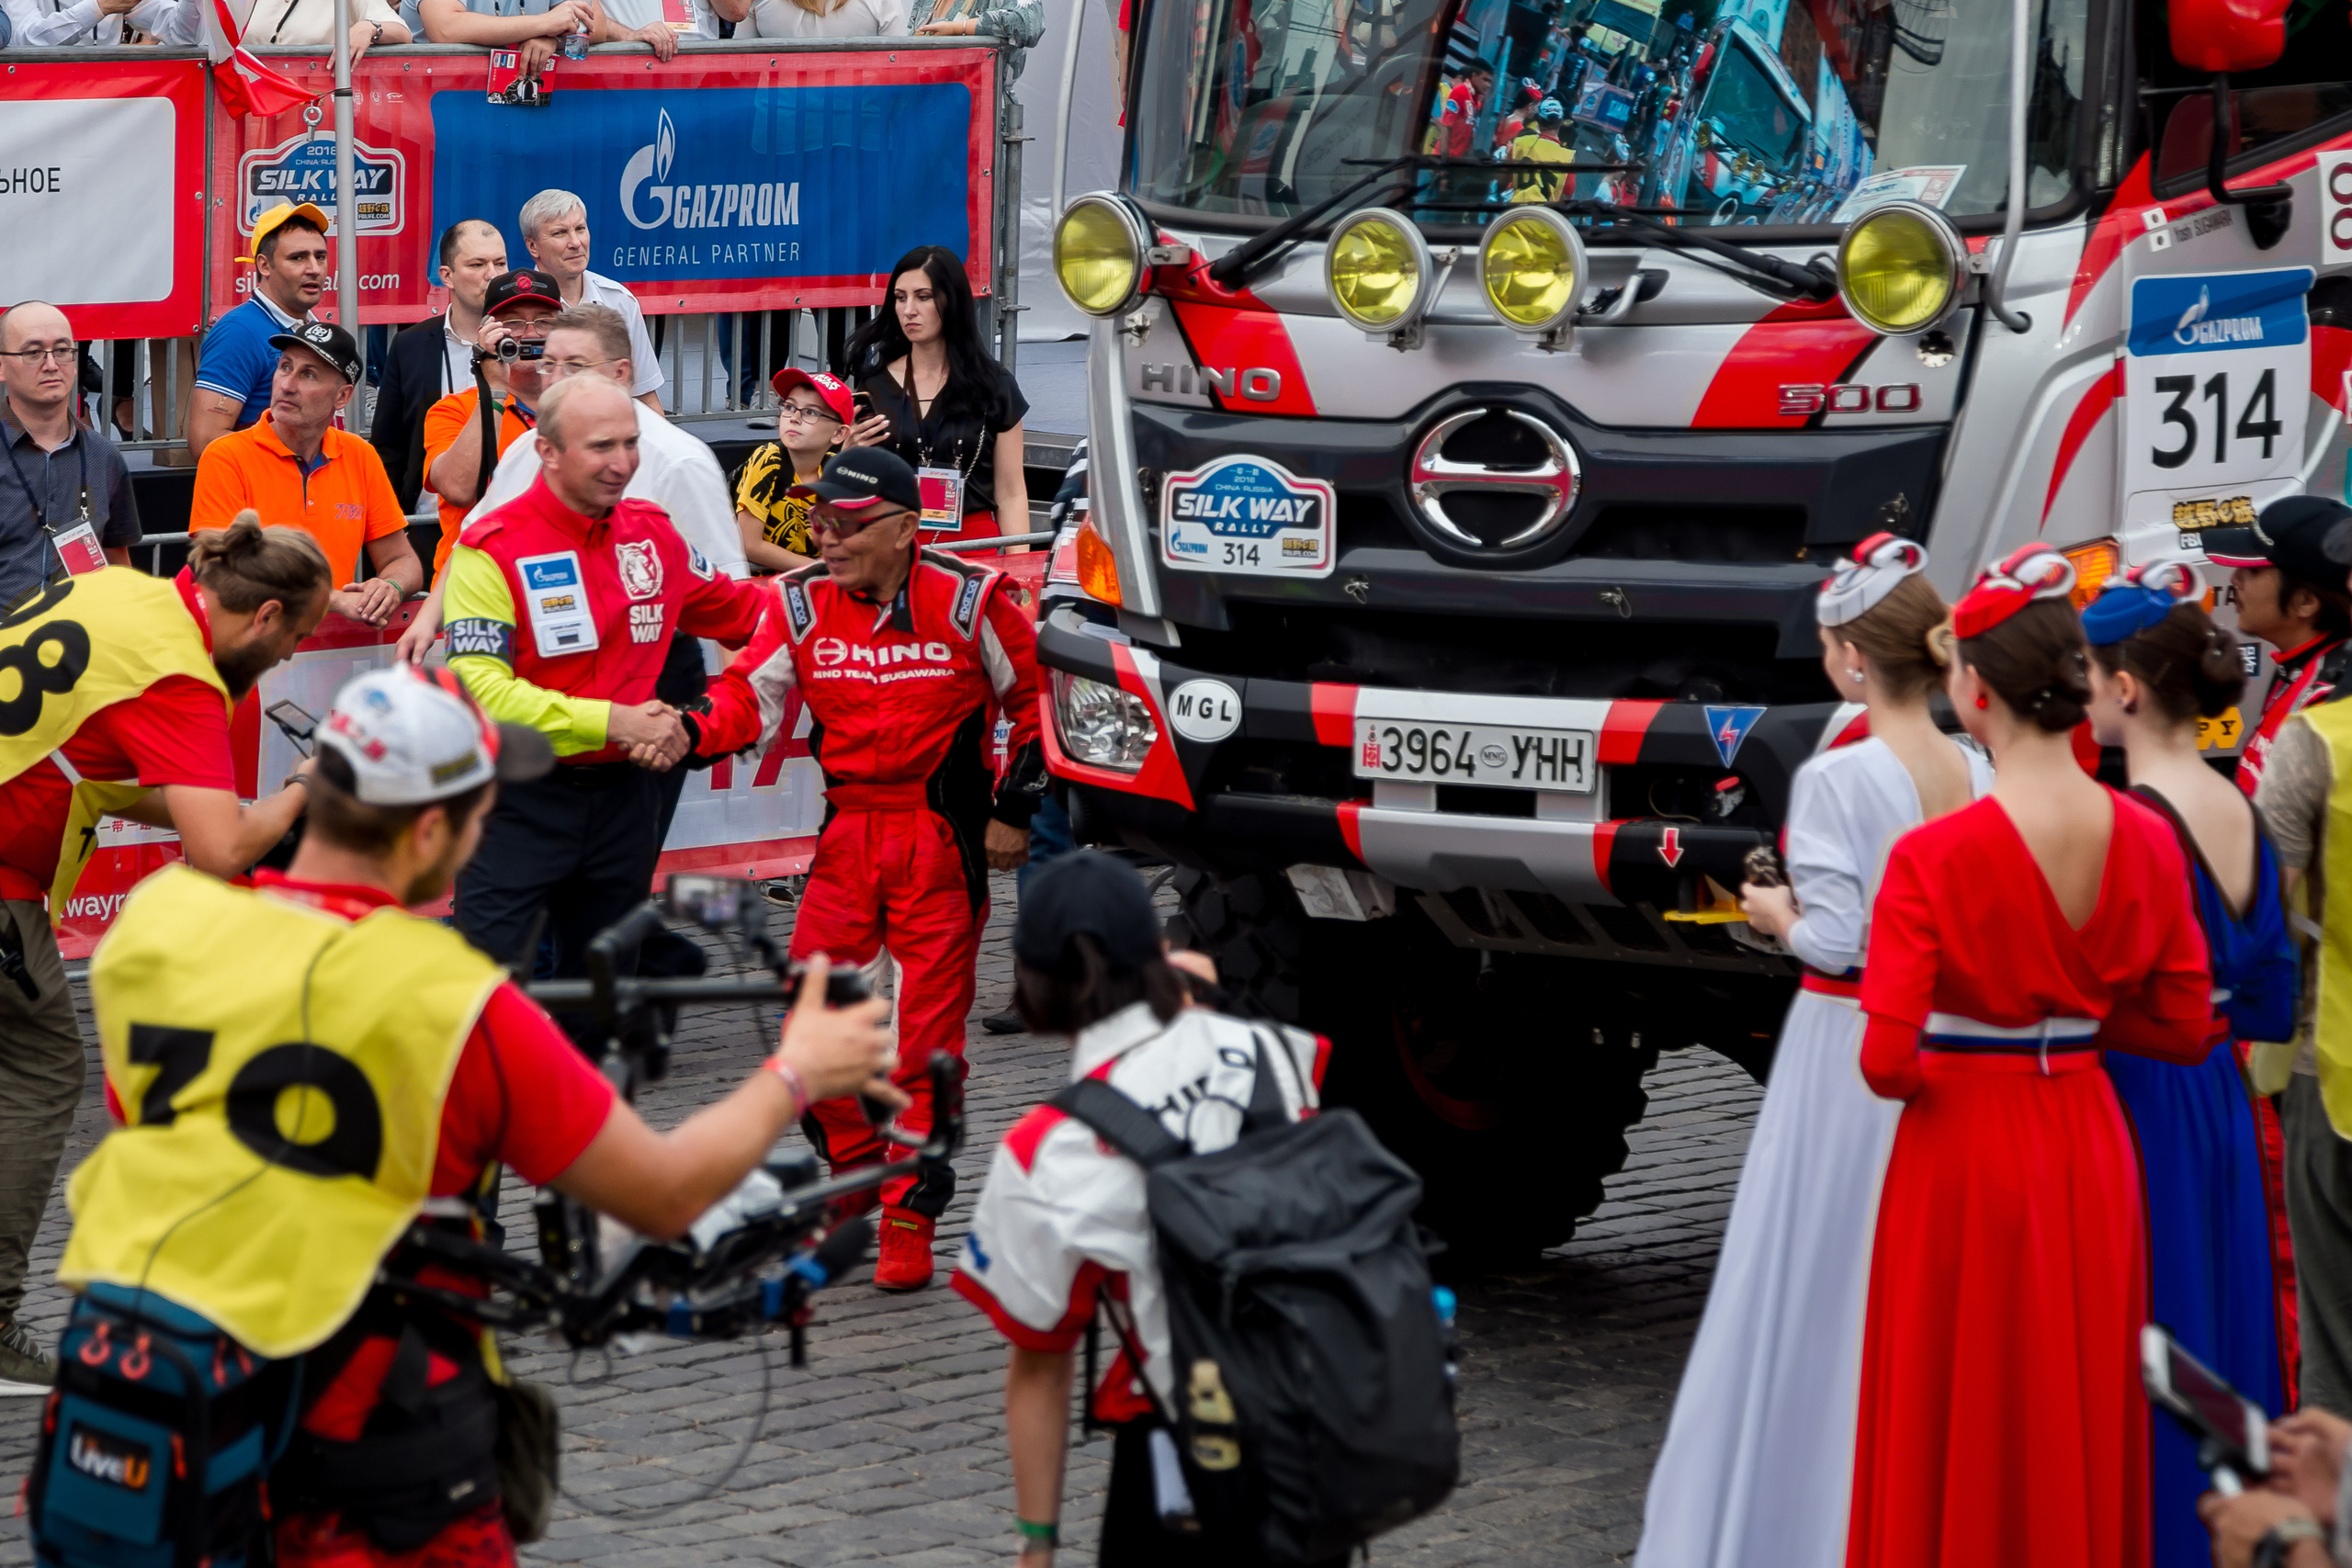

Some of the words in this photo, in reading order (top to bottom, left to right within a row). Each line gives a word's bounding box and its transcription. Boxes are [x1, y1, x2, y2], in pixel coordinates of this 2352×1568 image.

[307, 146, 336, 156] 2018
[257, 169, 325, 190] SILK
[297, 193, 337, 202] RALL
[673, 182, 800, 229] GAZPROM
[614, 245, 701, 267] GENERAL
[711, 242, 800, 264] PARTNER
[2199, 317, 2264, 344] GAZPROM
[1142, 362, 1282, 402] HINO
[1779, 383, 1922, 415] 500
[2152, 368, 2284, 469] 314
[847, 469, 878, 484] HINO
[1177, 493, 1245, 519] SILK
[1250, 497, 1315, 523] WAY
[1214, 522, 1272, 534] RALLY
[1223, 542, 1261, 566] 314
[788, 586, 808, 626] sparco
[958, 579, 979, 622] sparco
[629, 604, 664, 624] SILK
[454, 620, 503, 637] SILK
[630, 624, 662, 644] WAY
[454, 636, 503, 654] WAY
[852, 642, 952, 668] HINO
[813, 670, 842, 679] HINO
[844, 670, 877, 684] TEAM
[880, 668, 956, 684] SUGAWARA
[1177, 694, 1232, 723] MGL
[1382, 726, 1476, 778] 3964
[1484, 751, 1506, 762] MNG
